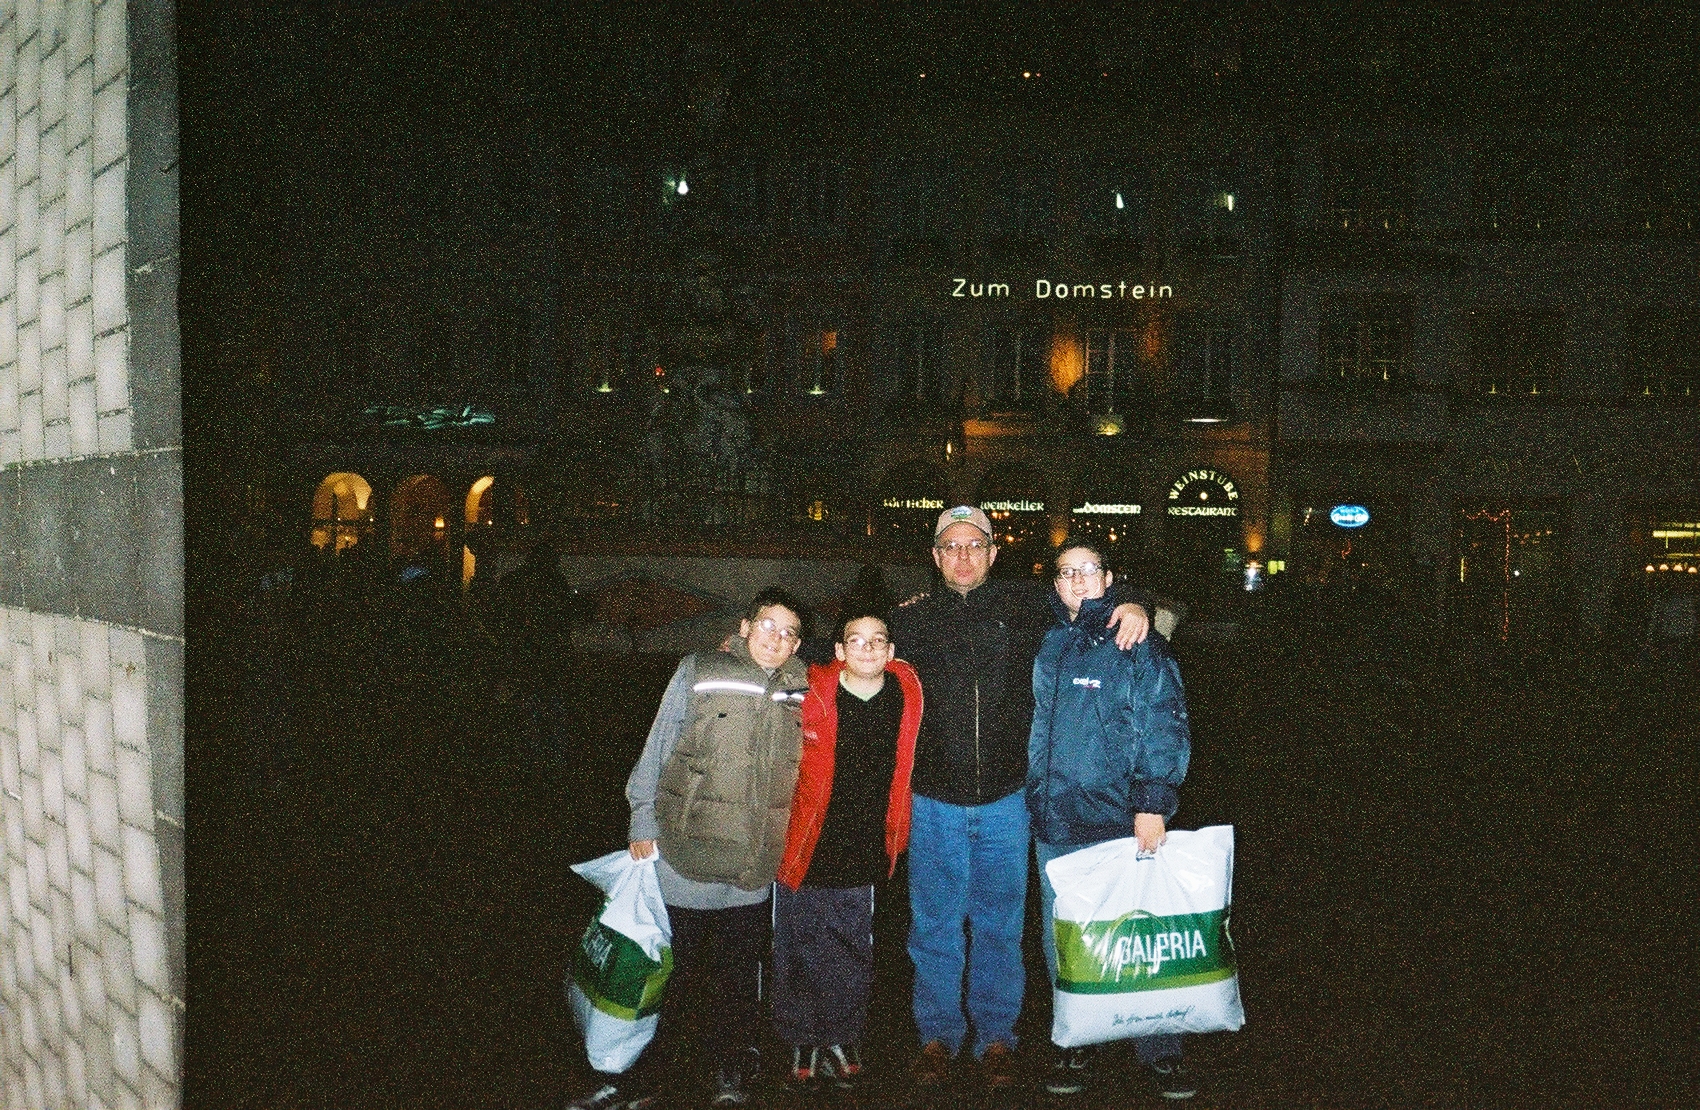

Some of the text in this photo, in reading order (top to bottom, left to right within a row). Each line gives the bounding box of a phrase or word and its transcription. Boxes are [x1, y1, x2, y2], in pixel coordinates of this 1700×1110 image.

[952, 278, 1173, 299] Zum Domstein
[1168, 469, 1239, 501] WEINSTUBE
[1118, 930, 1207, 965] GALERIA
